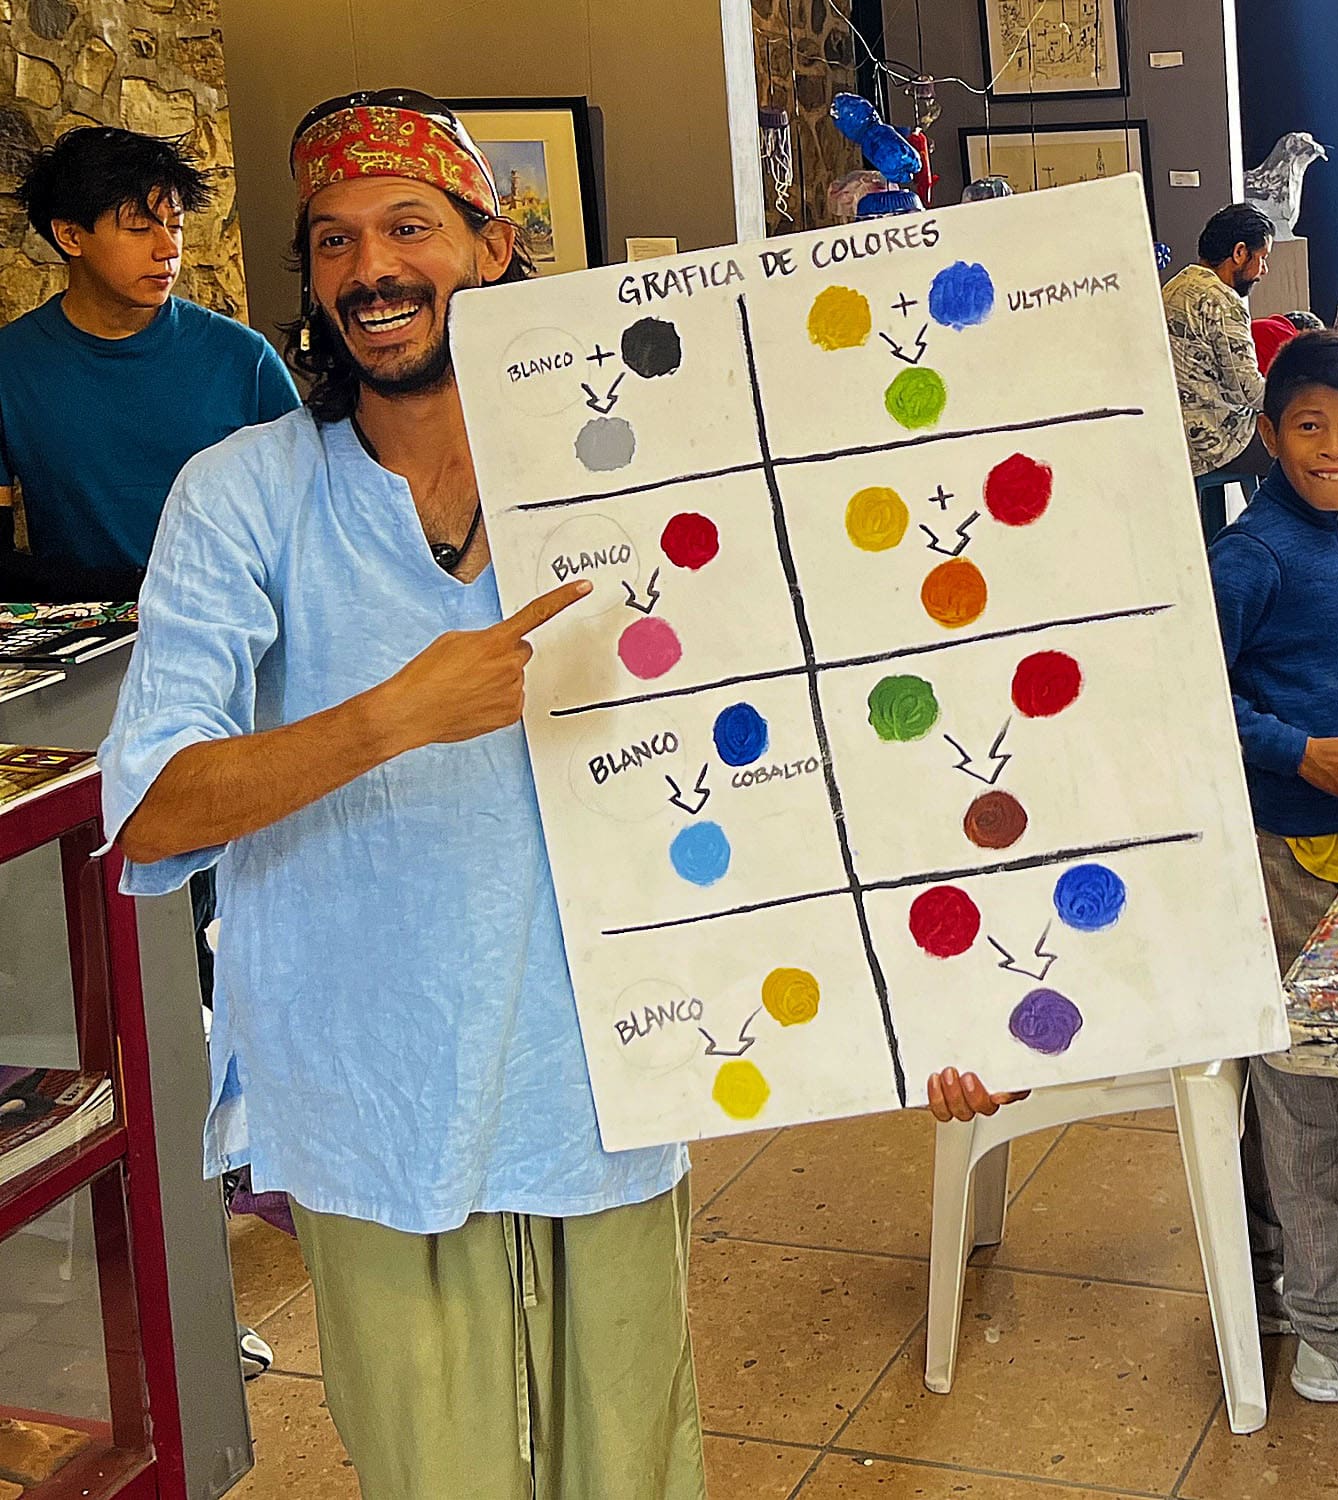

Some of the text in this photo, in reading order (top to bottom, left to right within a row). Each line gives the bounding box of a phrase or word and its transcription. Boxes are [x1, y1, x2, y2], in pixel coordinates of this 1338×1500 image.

[617, 219, 940, 305] GRAFICA DE COLORES
[1007, 272, 1121, 311] ULTRAMAR
[506, 352, 574, 383] BLANCO
[551, 544, 631, 582] BLANCO
[588, 732, 679, 784] BLANCO
[731, 756, 819, 789] COBALTO
[614, 998, 704, 1046] BLANCO
